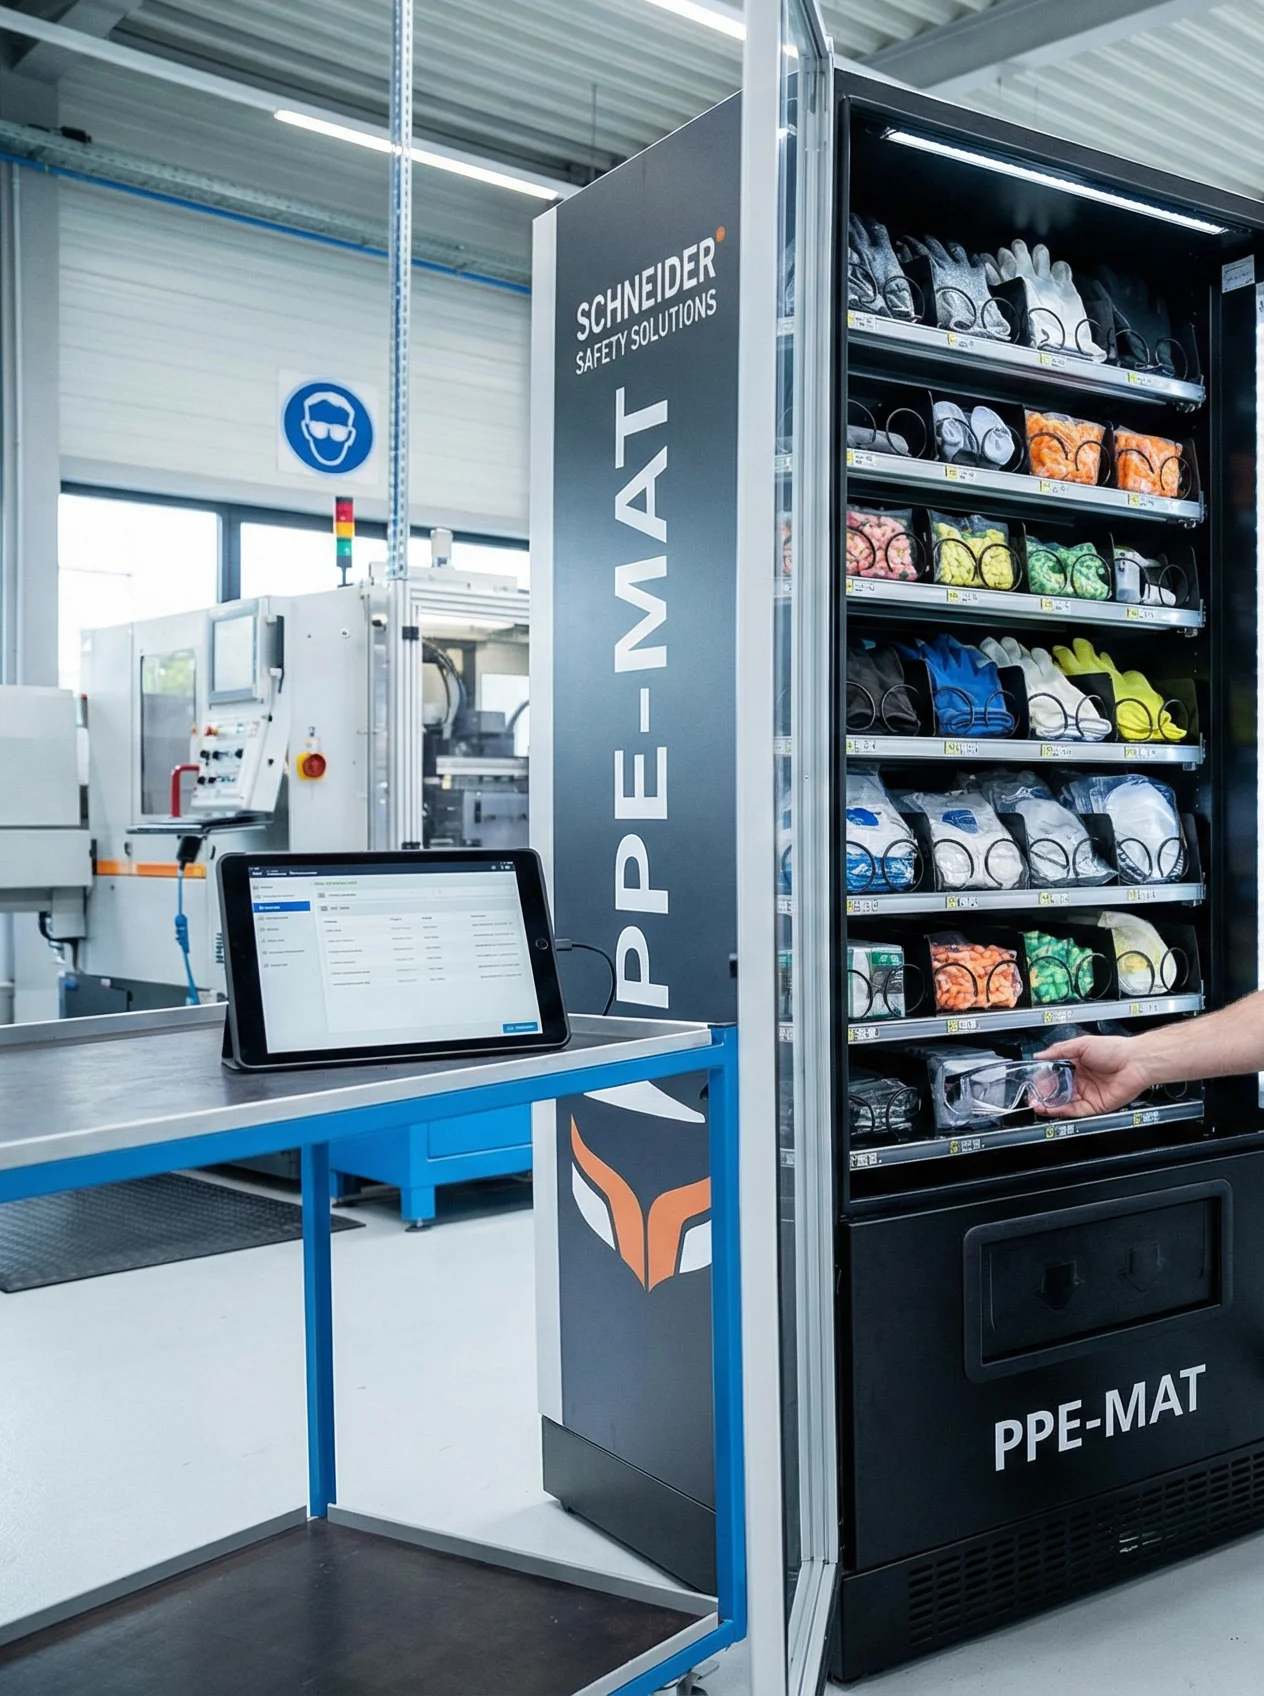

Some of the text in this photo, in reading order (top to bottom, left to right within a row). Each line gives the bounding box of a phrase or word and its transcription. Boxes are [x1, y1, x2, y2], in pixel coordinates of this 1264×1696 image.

[575, 288, 717, 375] SAFETY SOLUTIONS
[576, 237, 716, 342] SCHNEIDER
[615, 387, 669, 1009] PPE-MAT
[995, 1364, 1206, 1471] PPE-MAT
